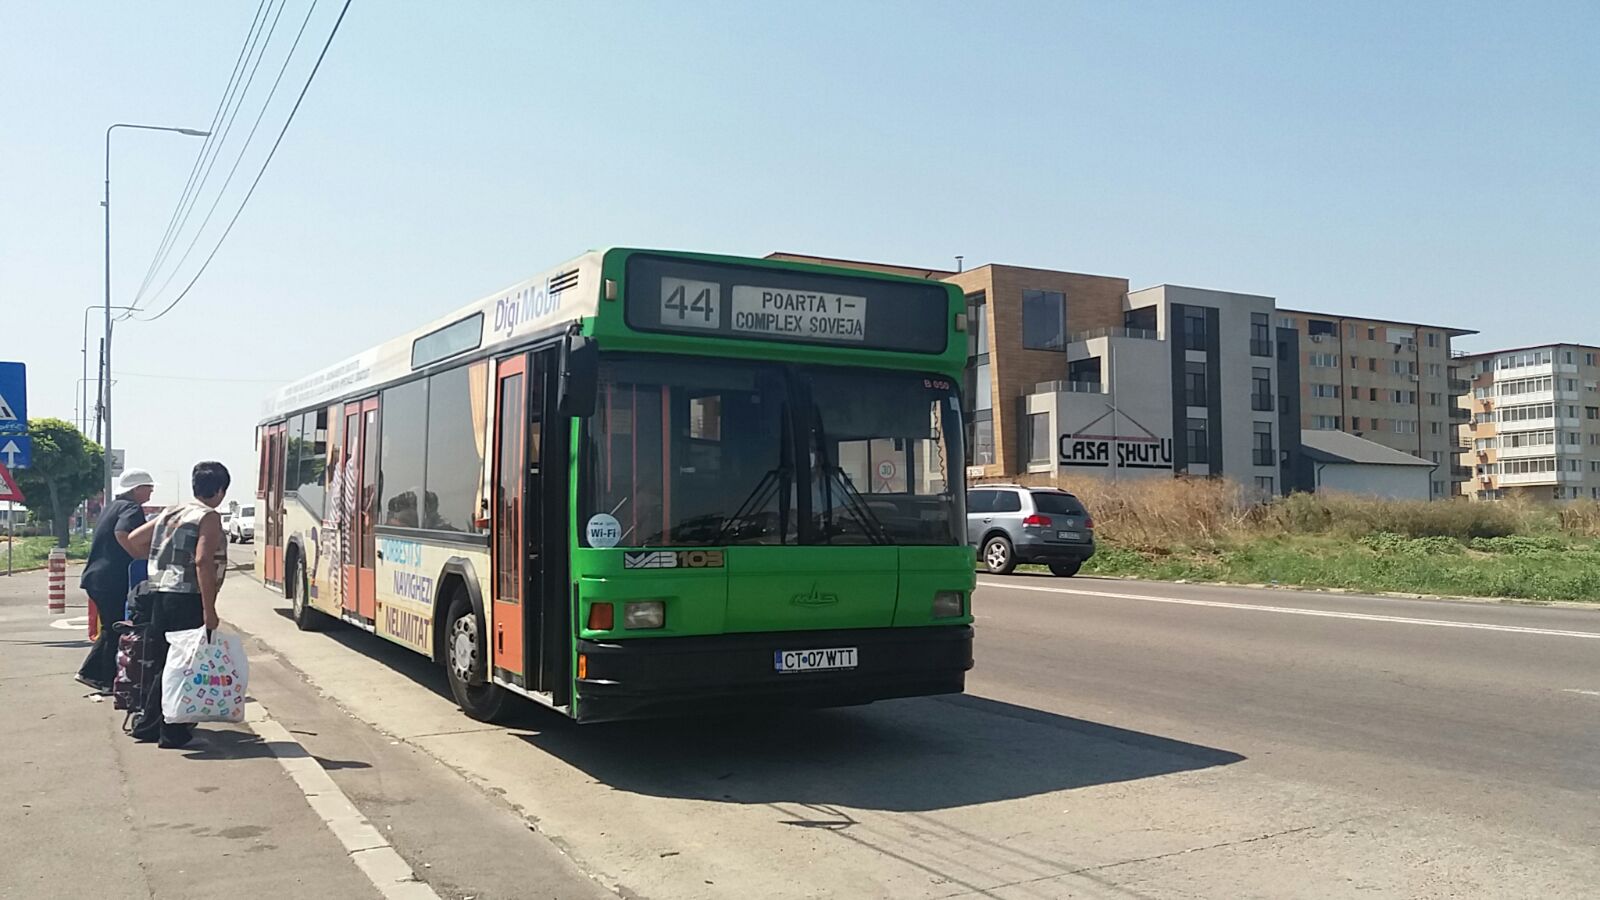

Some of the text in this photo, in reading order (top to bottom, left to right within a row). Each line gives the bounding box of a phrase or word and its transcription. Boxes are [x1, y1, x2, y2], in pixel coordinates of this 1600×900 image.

[494, 292, 520, 338] Digi
[664, 284, 714, 322] 44
[762, 291, 826, 313] POARTA
[736, 311, 863, 336] COMPLEX SOVEJA
[1059, 433, 1172, 468] CASA SHUTU
[881, 464, 892, 476] 30
[590, 528, 616, 538] Wi-Fi
[393, 570, 433, 605] NAVIGHEZI
[385, 605, 430, 649] NELIMITAT
